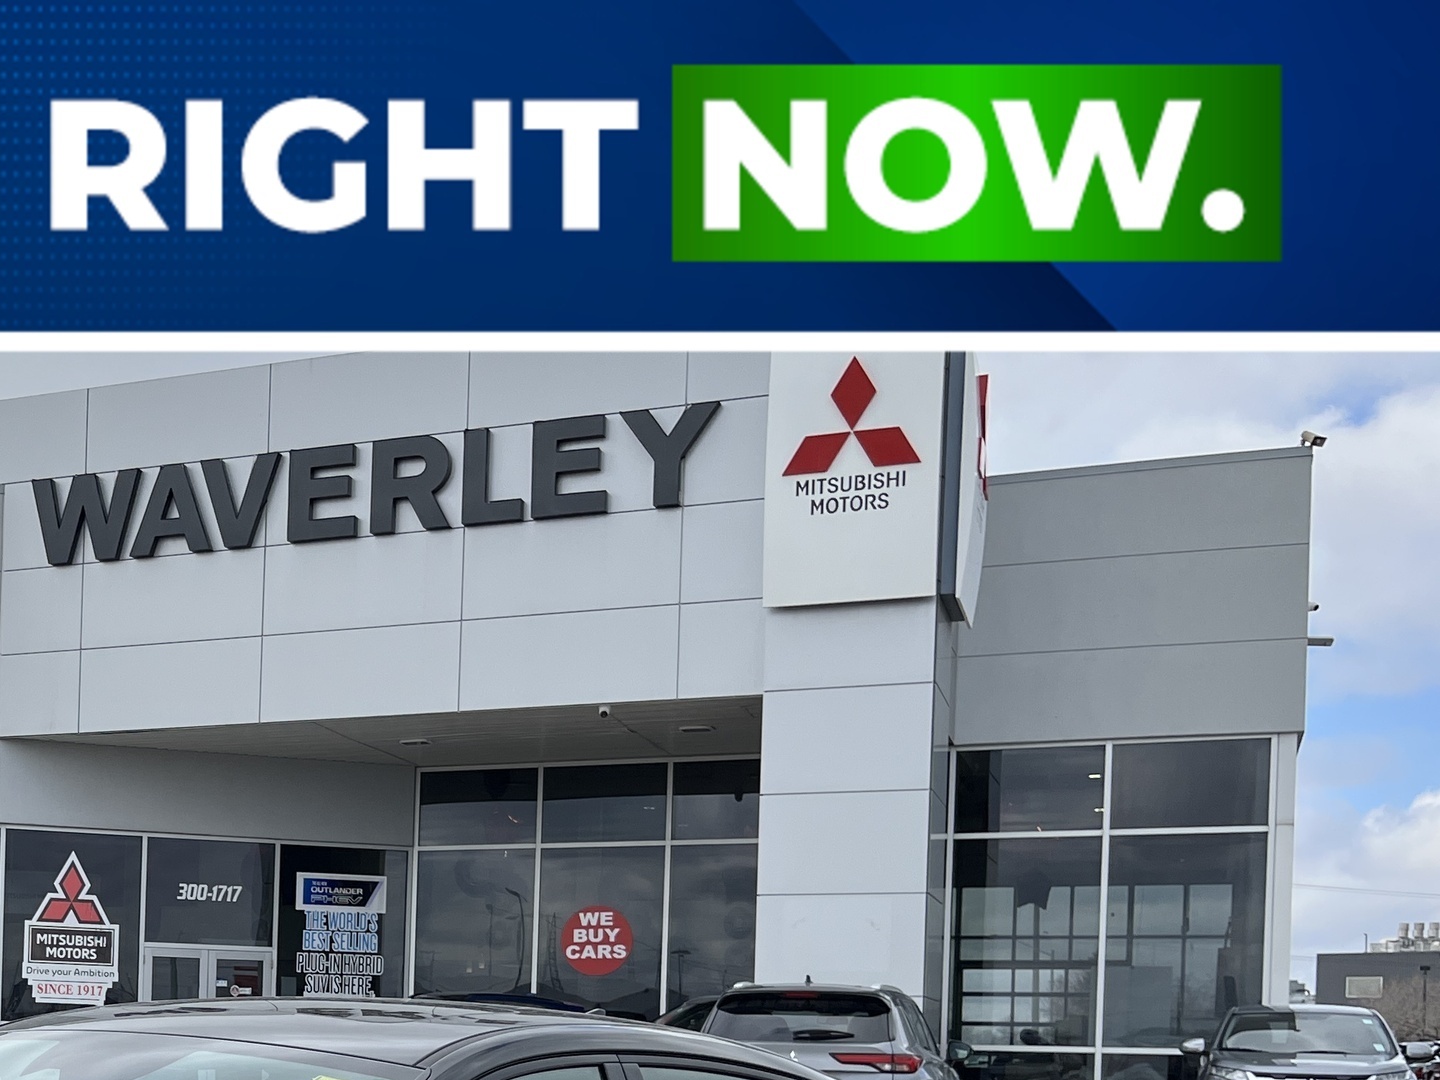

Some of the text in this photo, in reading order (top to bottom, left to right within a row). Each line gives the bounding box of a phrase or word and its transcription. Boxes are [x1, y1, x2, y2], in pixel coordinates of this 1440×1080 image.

[32, 401, 722, 567] WAVERLEY
[795, 471, 907, 497] MITSUBISHI
[810, 493, 890, 515] MOTORS
[176, 883, 243, 902] 300-1717
[311, 886, 363, 895] OUTLANDER
[311, 894, 363, 905] PHEV
[304, 910, 378, 932] THE WORLD'S
[579, 912, 613, 926] WE
[36, 933, 107, 947] MITSUBISHI
[303, 930, 378, 953] BEST SELLING
[573, 928, 620, 943] BUY
[46, 947, 97, 959] MOTORS
[565, 944, 627, 959] CARS
[296, 952, 384, 975] PLUG-IN HYBRID
[26, 966, 115, 977] Drive your Ambition
[37, 984, 103, 996] SINCE 1917
[305, 974, 328, 994] SUV
[329, 975, 341, 994] IS
